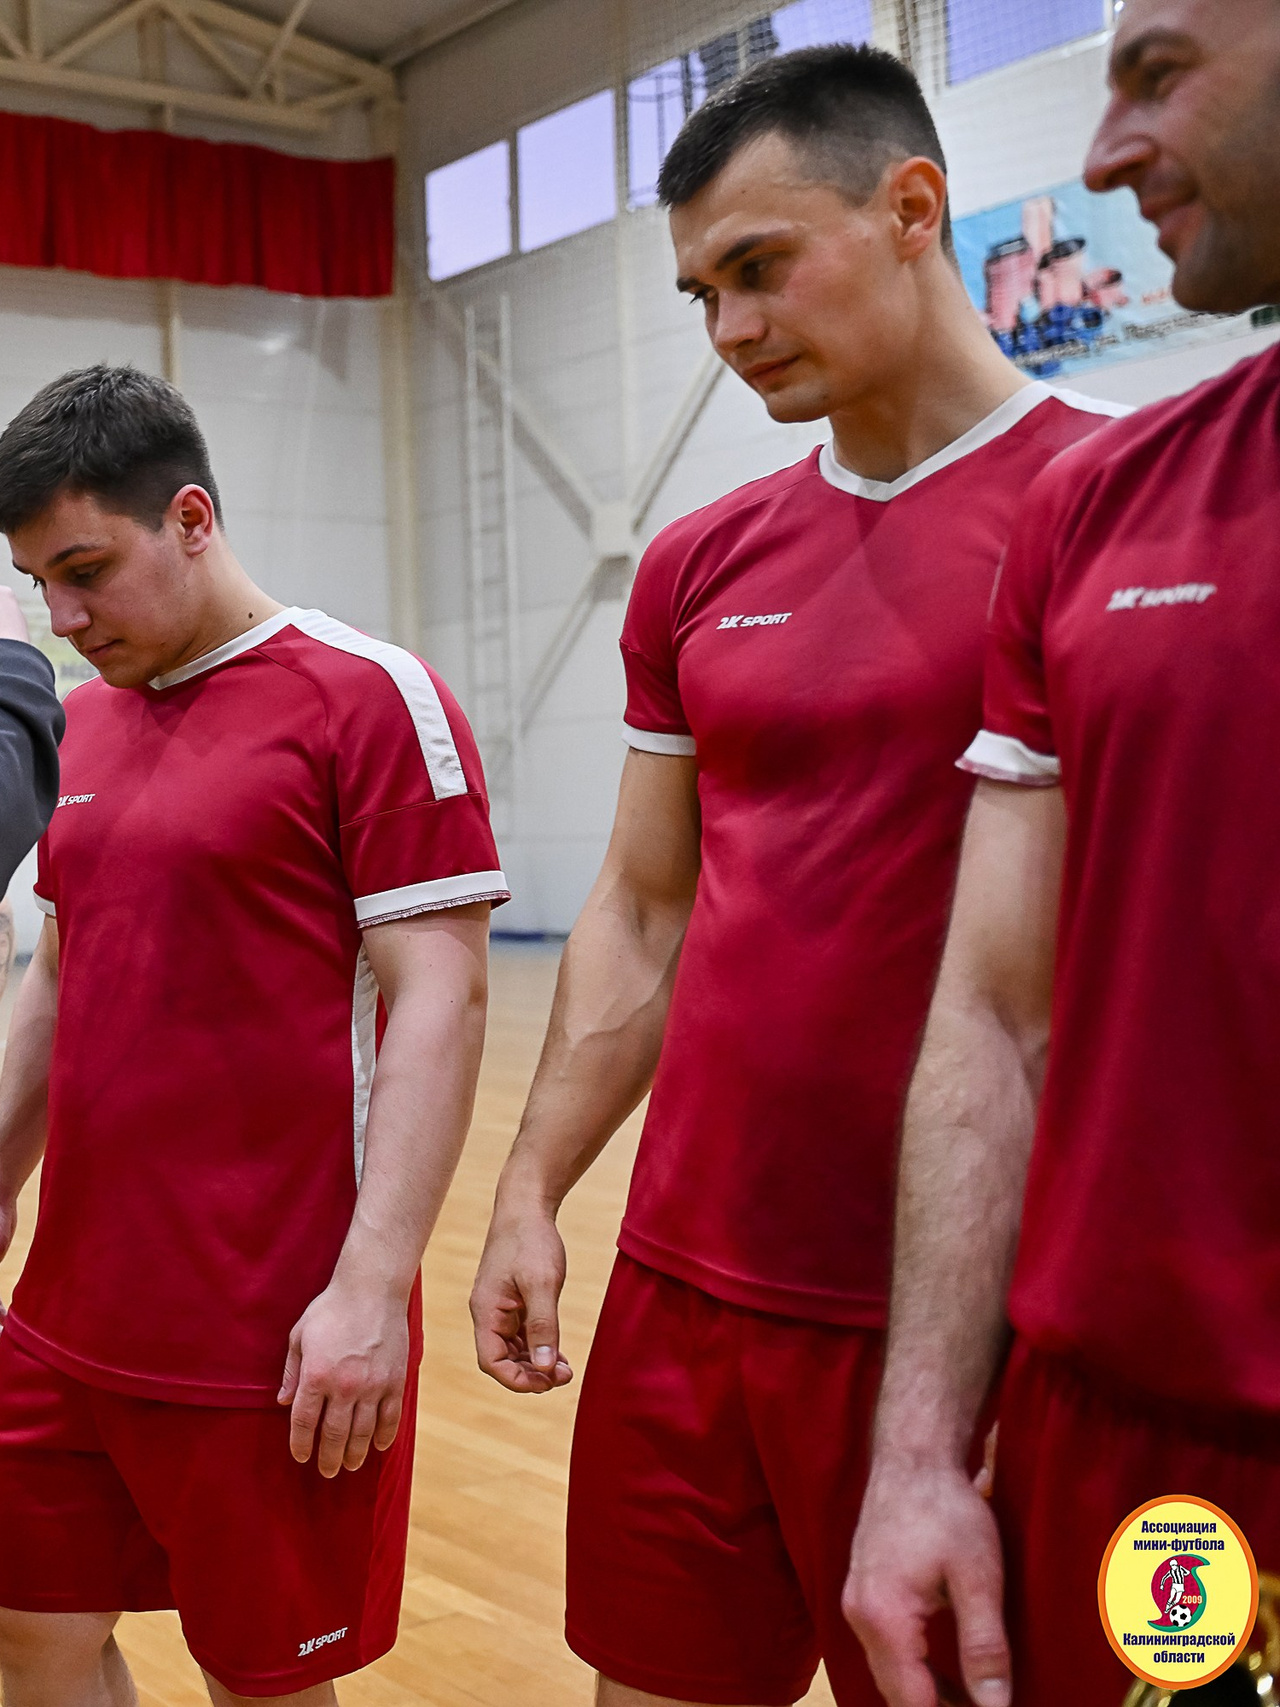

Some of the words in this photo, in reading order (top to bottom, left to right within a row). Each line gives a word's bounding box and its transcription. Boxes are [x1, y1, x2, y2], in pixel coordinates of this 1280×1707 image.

[716, 614, 744, 630] 2K
[740, 612, 793, 627] SPORT
[67, 793, 96, 805] SPORT
[297, 1637, 315, 1657] 2K
[314, 1627, 349, 1649] SPORT
